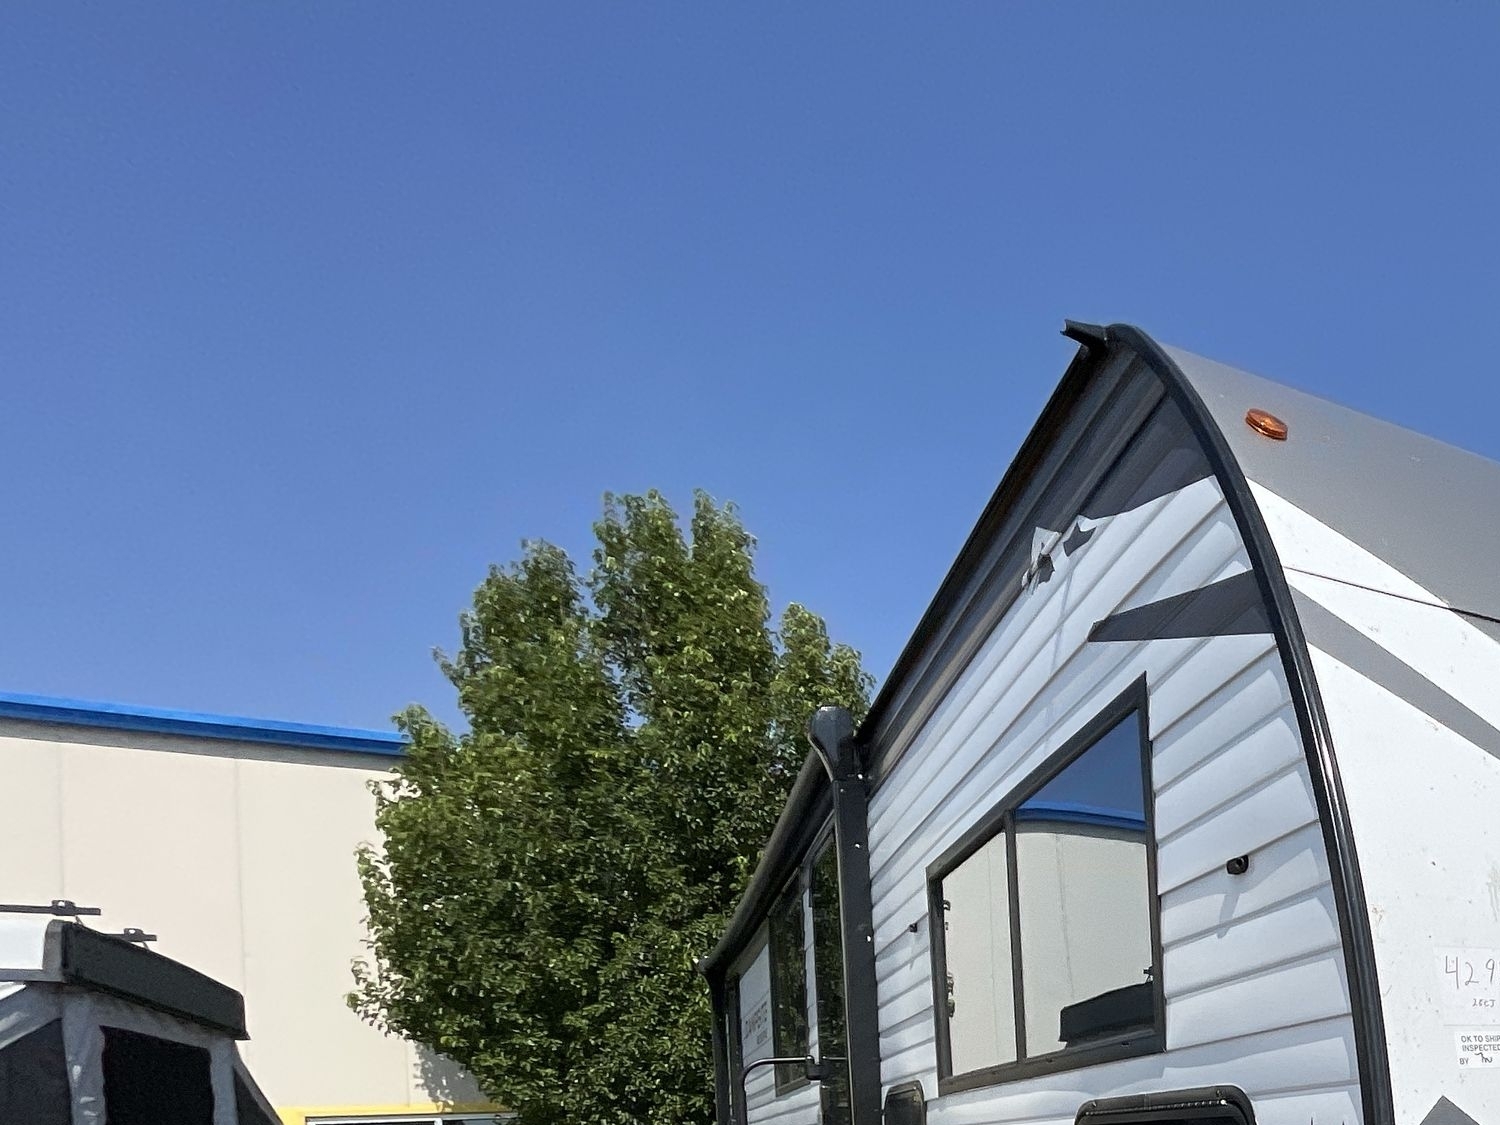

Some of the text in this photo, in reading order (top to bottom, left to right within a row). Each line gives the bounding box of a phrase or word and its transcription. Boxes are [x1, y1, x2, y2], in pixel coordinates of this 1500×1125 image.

[1460, 1034, 1472, 1043] OK
[1473, 1034, 1484, 1043] TO
[1459, 1057, 1469, 1065] BY
